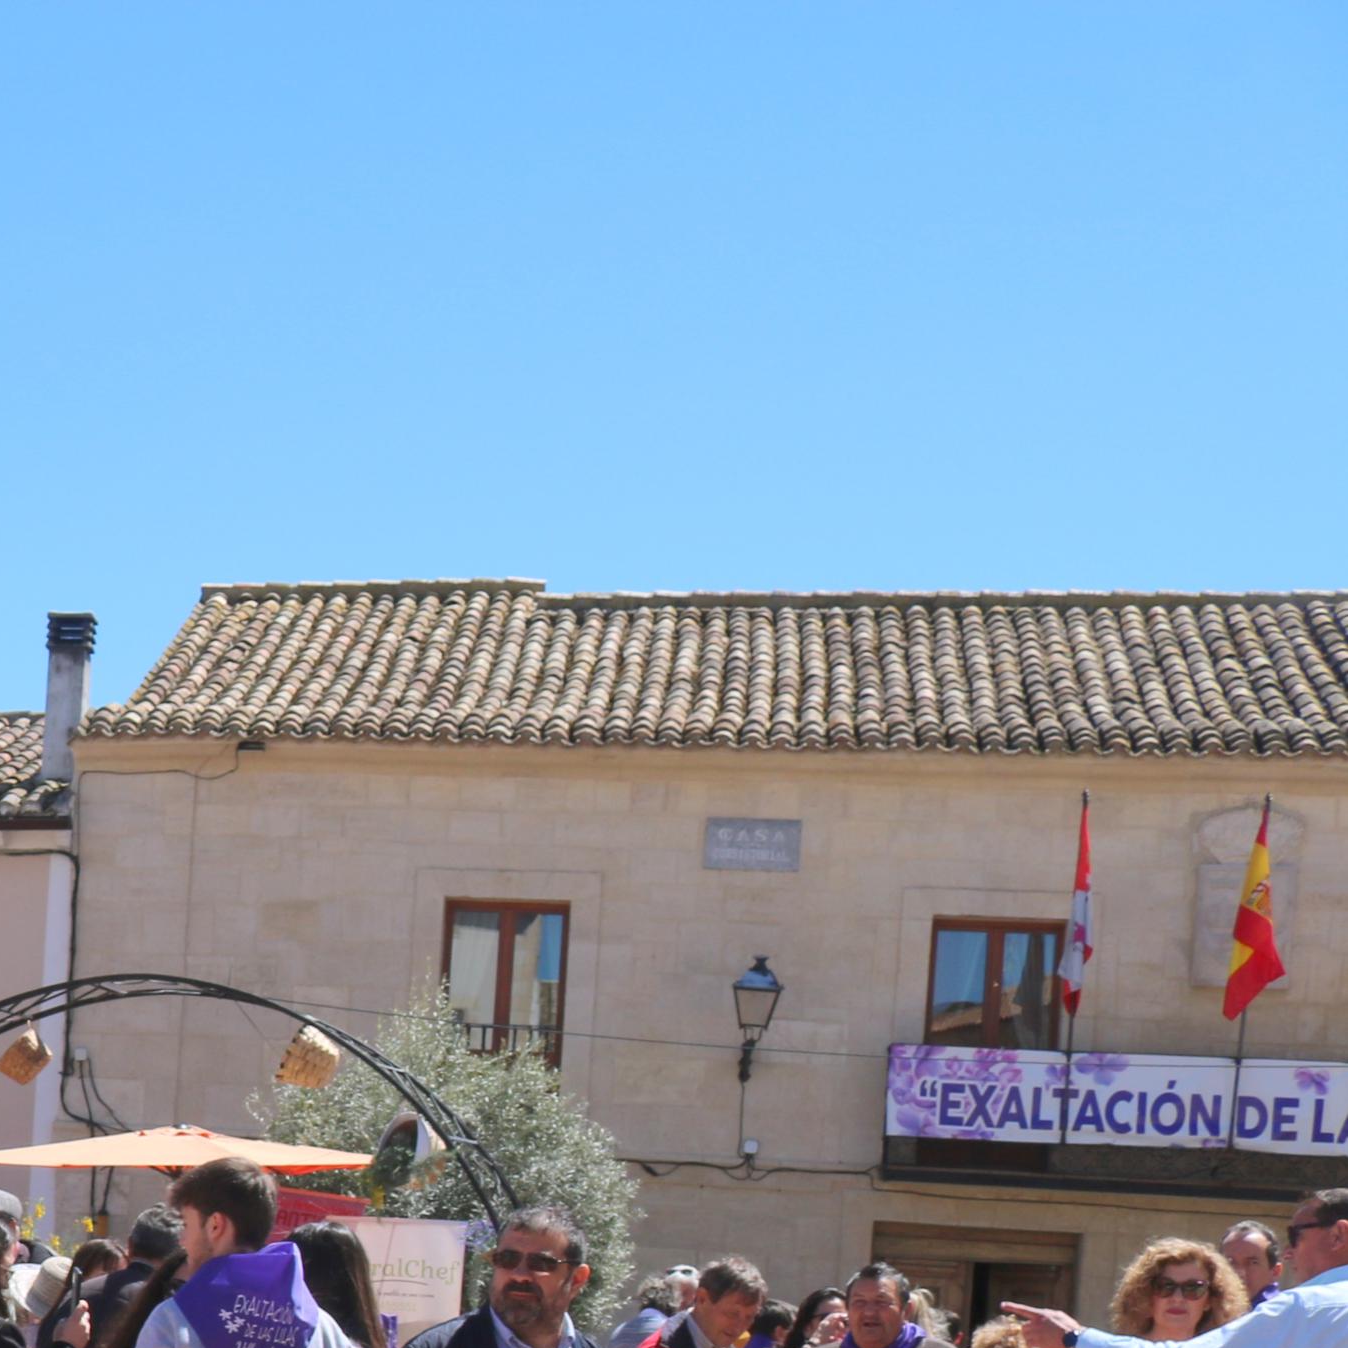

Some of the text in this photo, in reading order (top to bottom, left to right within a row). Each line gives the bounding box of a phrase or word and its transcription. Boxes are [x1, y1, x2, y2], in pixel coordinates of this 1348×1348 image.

[1236, 1095, 1300, 1141] DE
[244, 1322, 257, 1338] DE
[257, 1326, 274, 1342] LAS
